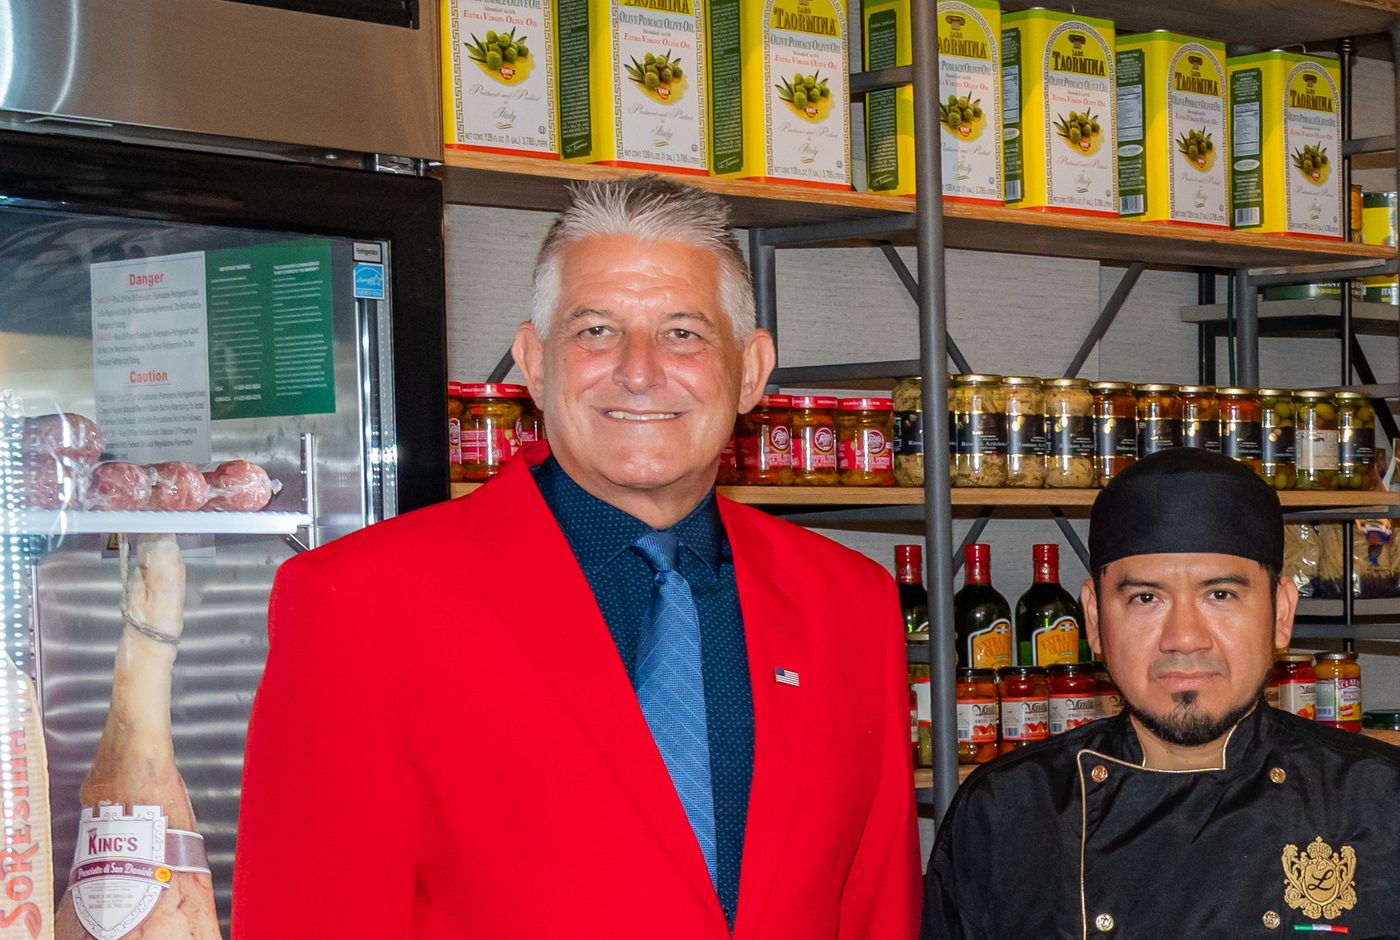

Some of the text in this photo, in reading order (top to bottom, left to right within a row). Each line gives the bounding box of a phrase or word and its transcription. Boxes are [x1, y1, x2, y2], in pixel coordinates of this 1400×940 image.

[619, 11, 638, 24] OLIVE
[638, 14, 663, 28] POMACE
[664, 18, 683, 31] OLIVE
[774, 7, 836, 36] TAORMINA
[771, 34, 788, 47] OLIVE
[788, 37, 812, 50] POMACE
[812, 40, 830, 53] OLIVE
[938, 37, 987, 58] AORMINA
[941, 59, 964, 72] POMACE
[964, 62, 981, 74] OLIVE
[1052, 50, 1105, 77] TAORMINA
[1175, 72, 1218, 96] TAORMINA
[1290, 90, 1333, 112] TAORMINA
[128, 273, 165, 287] Danger
[129, 369, 168, 383] Caution
[88, 834, 138, 855] KING'S
[111, 862, 123, 874] San
